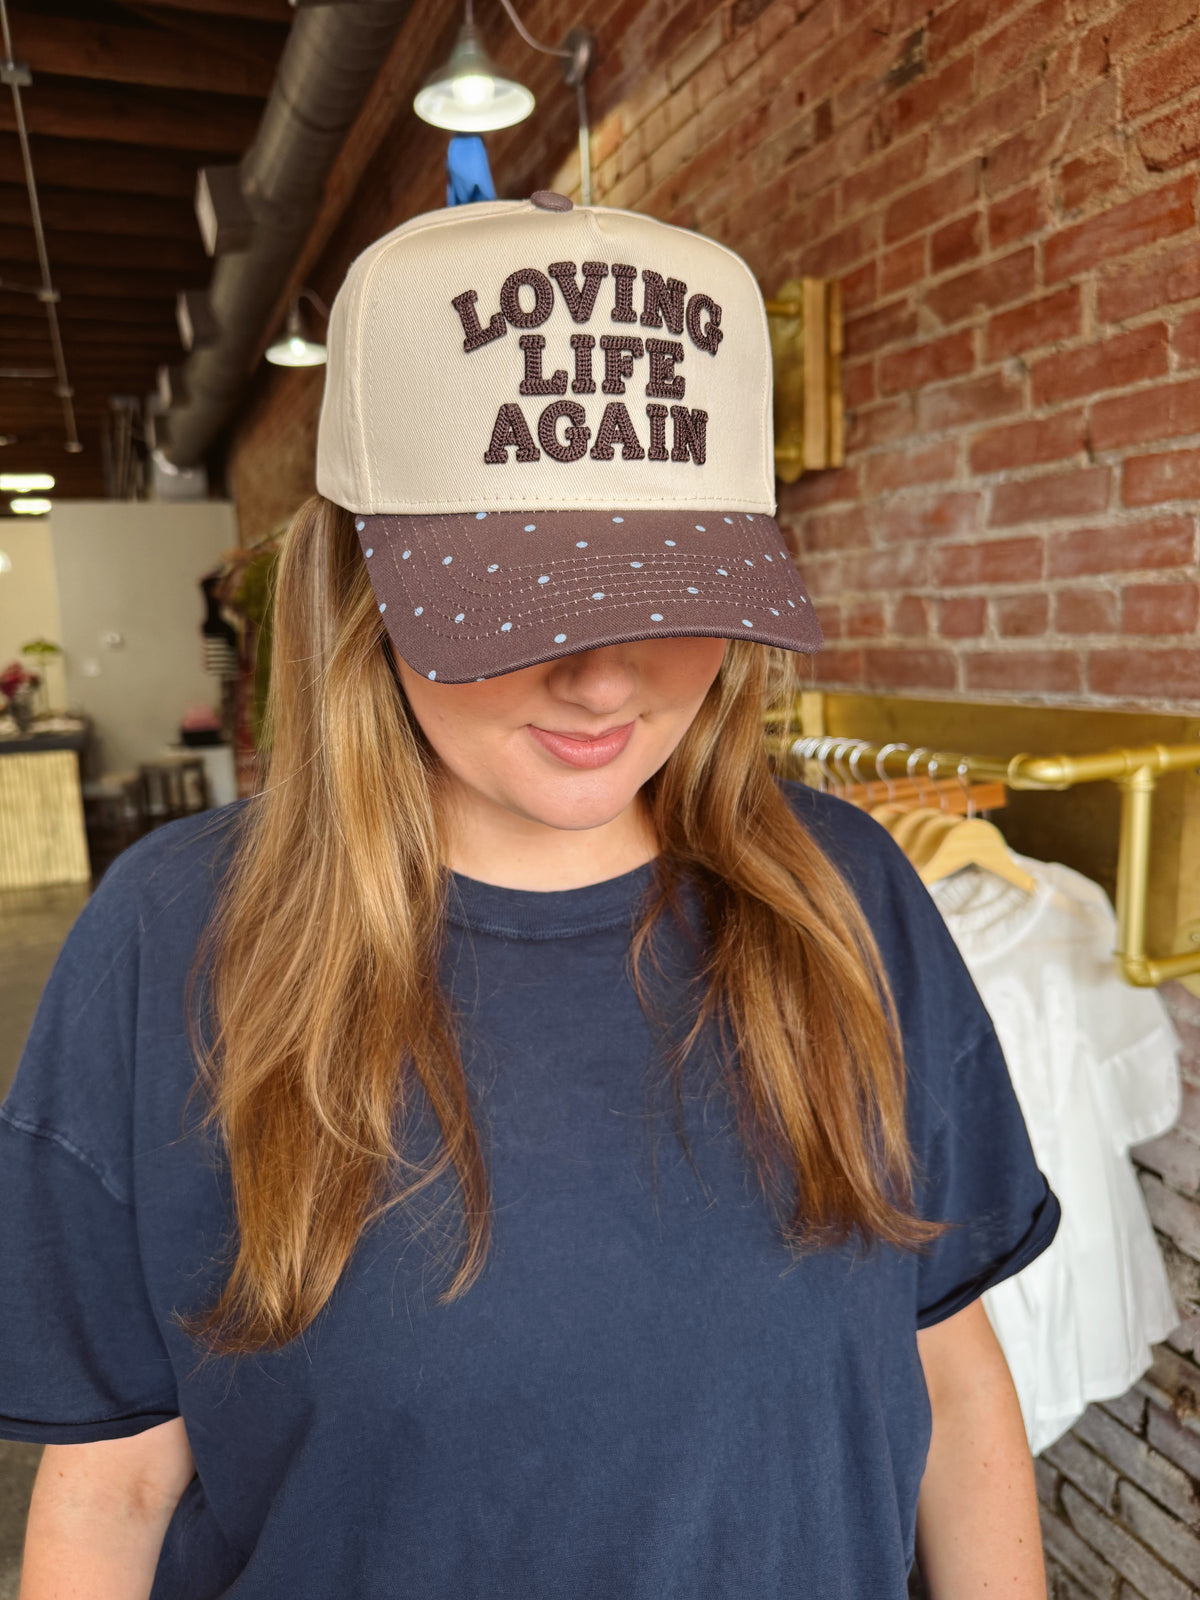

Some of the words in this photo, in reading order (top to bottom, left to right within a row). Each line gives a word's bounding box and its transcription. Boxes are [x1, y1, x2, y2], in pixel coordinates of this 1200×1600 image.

[452, 261, 724, 356] LOVING
[518, 334, 686, 400] LIFE
[484, 400, 709, 465] AGAIN
